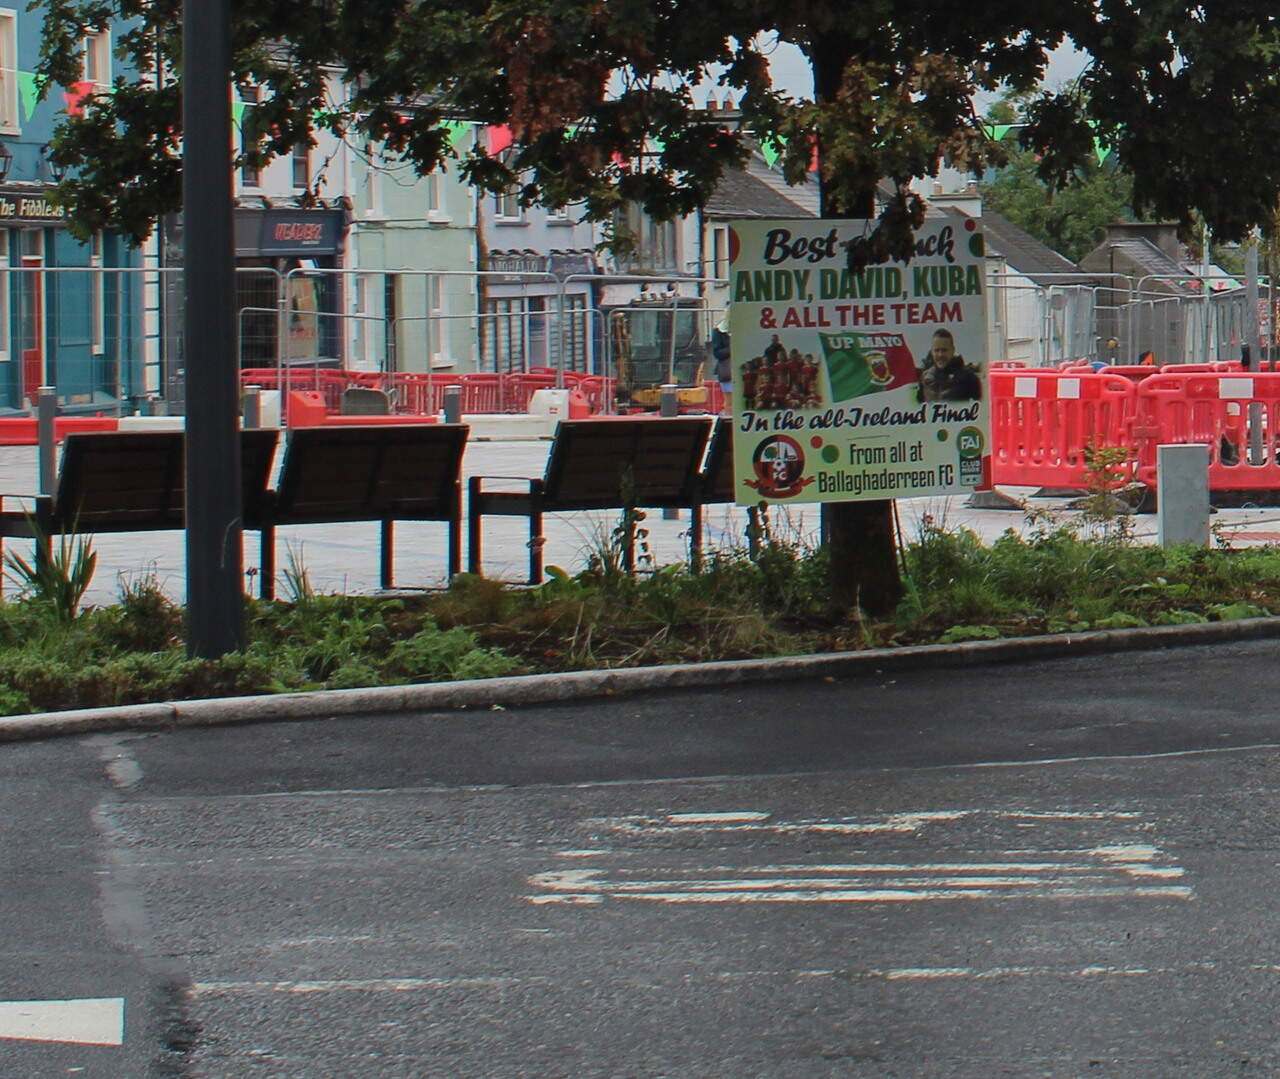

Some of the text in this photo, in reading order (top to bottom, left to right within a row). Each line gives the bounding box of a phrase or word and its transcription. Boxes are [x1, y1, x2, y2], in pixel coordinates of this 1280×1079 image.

[764, 228, 838, 266] Best
[735, 264, 983, 304] ANDY, DAVID, KUBA
[759, 302, 964, 329] & ALL THE TEAM
[741, 402, 980, 433] In the all-Ireland Final
[890, 442, 907, 463] all
[910, 440, 924, 461] at
[961, 435, 980, 449] FAI
[818, 464, 955, 496] Ballaghaderreen FC
